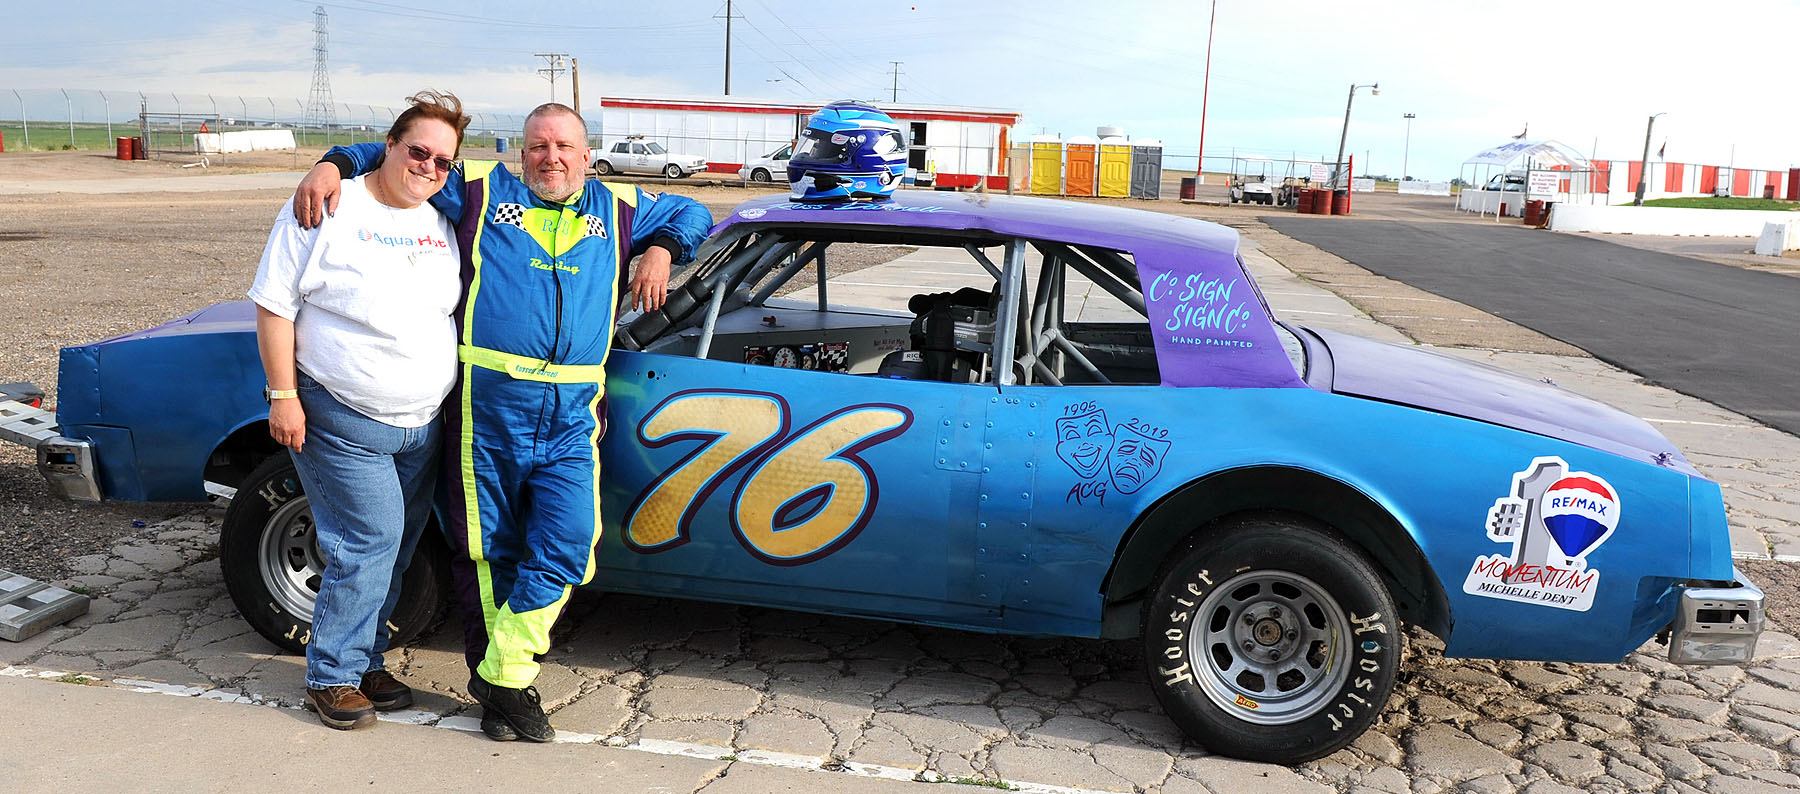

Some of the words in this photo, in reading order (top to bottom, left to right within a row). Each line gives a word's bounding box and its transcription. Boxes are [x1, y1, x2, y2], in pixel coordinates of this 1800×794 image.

[529, 257, 581, 275] Racing
[1178, 272, 1238, 306] SIGN
[1171, 335, 1201, 345] HAND
[1206, 338, 1253, 348] PAINTED
[1063, 400, 1097, 416] 1995
[1127, 417, 1169, 439] 2019
[621, 388, 915, 567] 76
[1066, 479, 1109, 508] ACG
[1551, 496, 1608, 517] RE/MAX
[1474, 558, 1595, 594] MOMENTUM
[1477, 582, 1541, 600] MICHELLE
[1542, 592, 1578, 606] DENT
[1158, 569, 1213, 687] Hoosier
[1328, 611, 1388, 732] Hoosier
